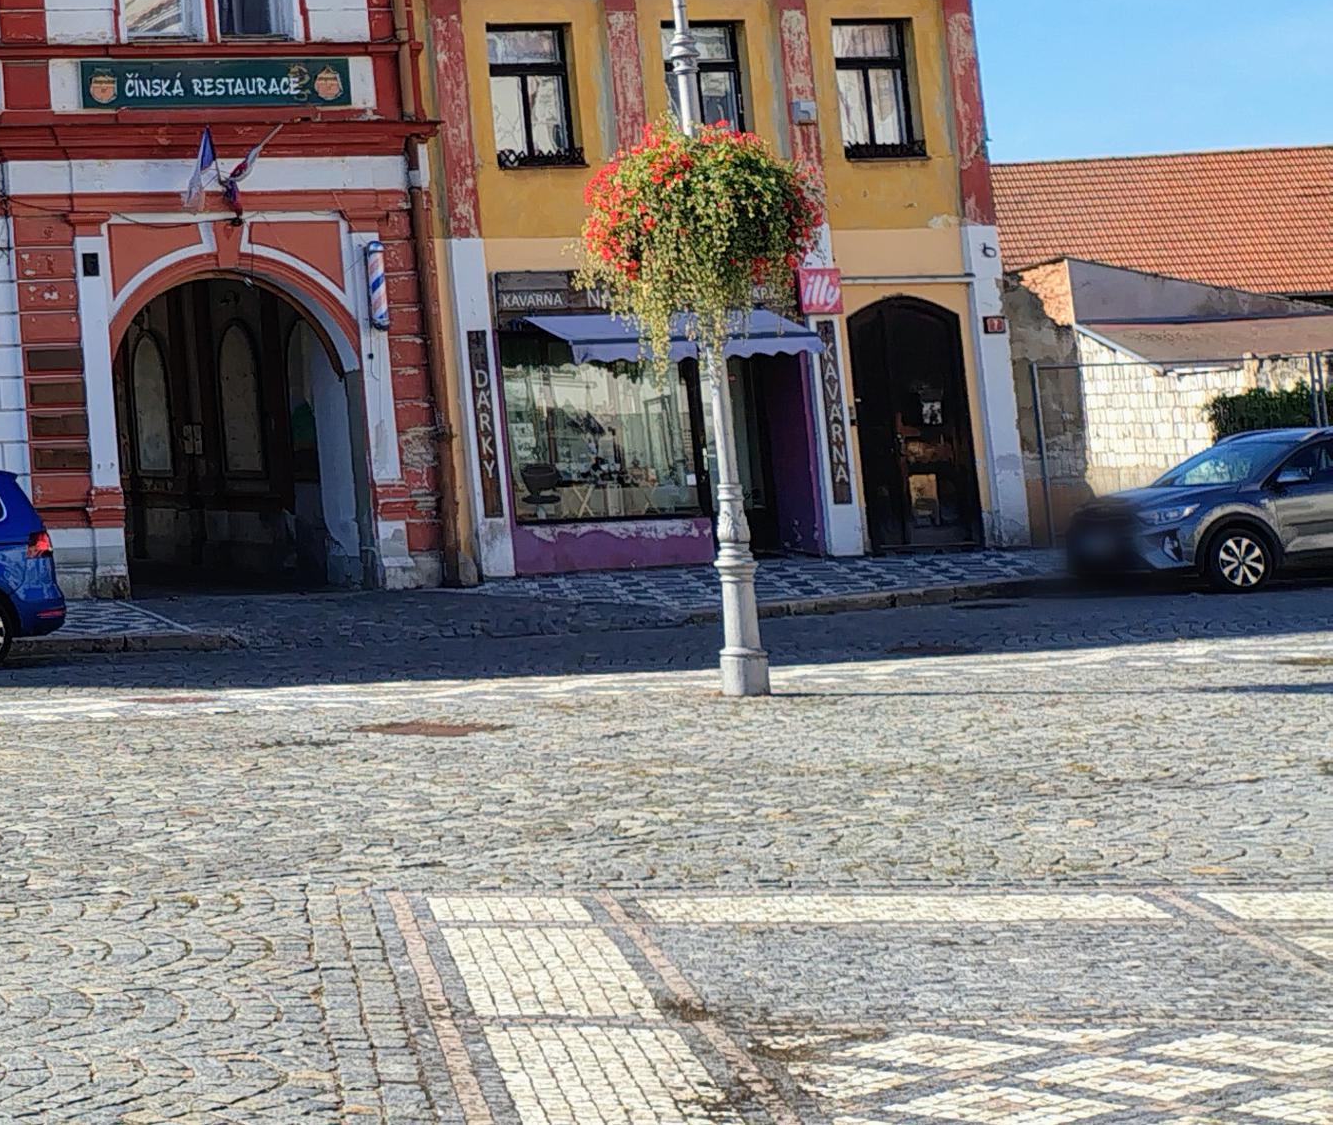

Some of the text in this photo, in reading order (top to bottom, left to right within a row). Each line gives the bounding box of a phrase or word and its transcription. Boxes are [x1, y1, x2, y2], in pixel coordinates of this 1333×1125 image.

[125, 72, 301, 97] ČÍNSKÁ RESTAURACE
[803, 274, 840, 312] illy
[475, 369, 495, 479] DÁRKY
[824, 343, 849, 483] KAVÁRNA
